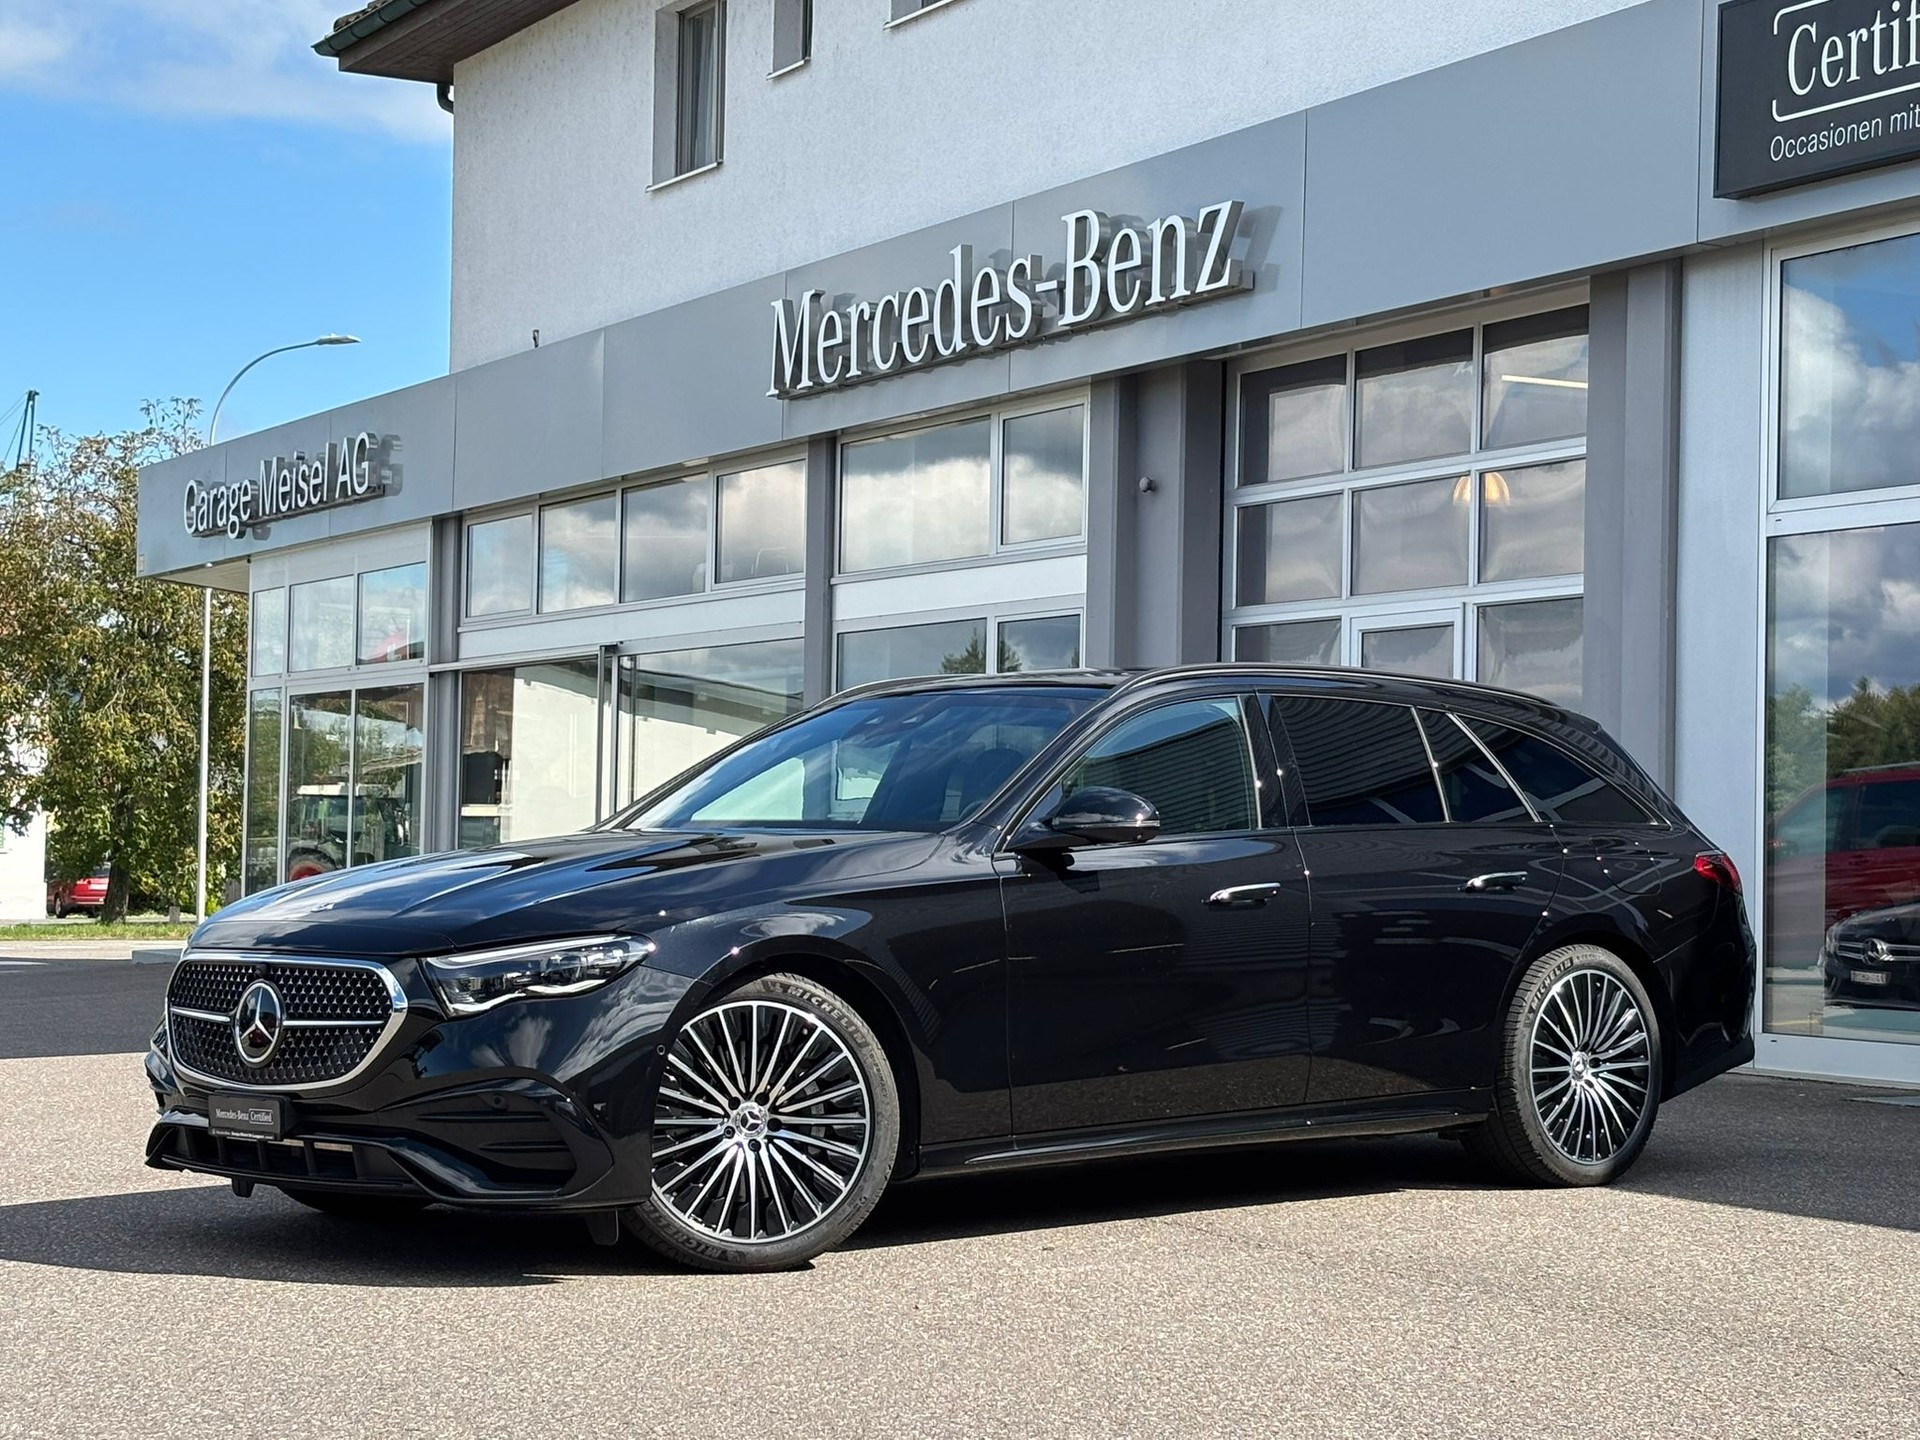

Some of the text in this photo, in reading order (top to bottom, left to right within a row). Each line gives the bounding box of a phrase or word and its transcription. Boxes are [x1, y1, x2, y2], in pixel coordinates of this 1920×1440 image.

[1770, 117, 1882, 162] Occasionen
[766, 200, 1236, 397] Mercedes-Benz
[183, 431, 370, 540] Garage Meisel AG
[1531, 957, 1574, 1010] MICHELIN
[787, 984, 868, 1045] MICHELIN
[215, 1108, 272, 1122] Mercedes-Benz Certified
